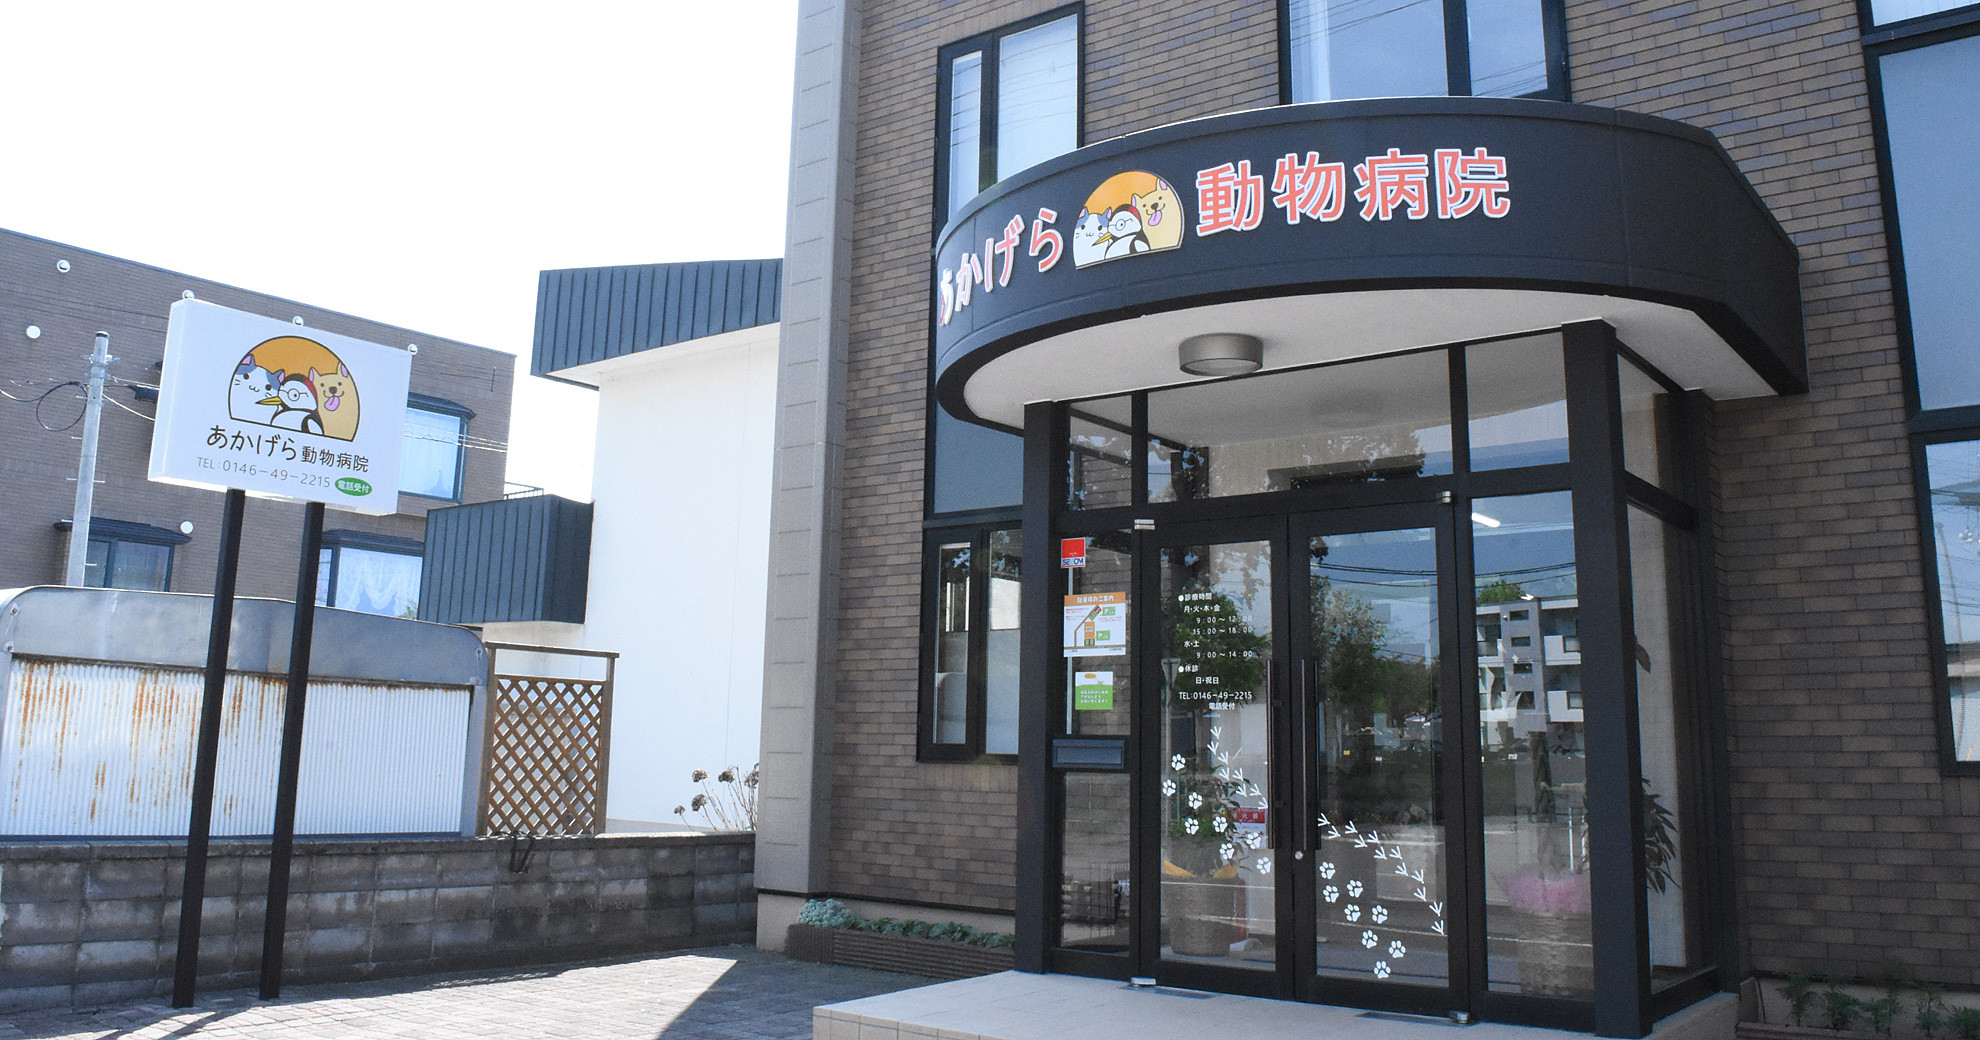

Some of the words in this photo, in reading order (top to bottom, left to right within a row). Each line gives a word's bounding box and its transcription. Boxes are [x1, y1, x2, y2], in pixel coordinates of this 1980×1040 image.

[1195, 147, 1511, 236] 動物病院
[336, 479, 371, 494] 電話受付
